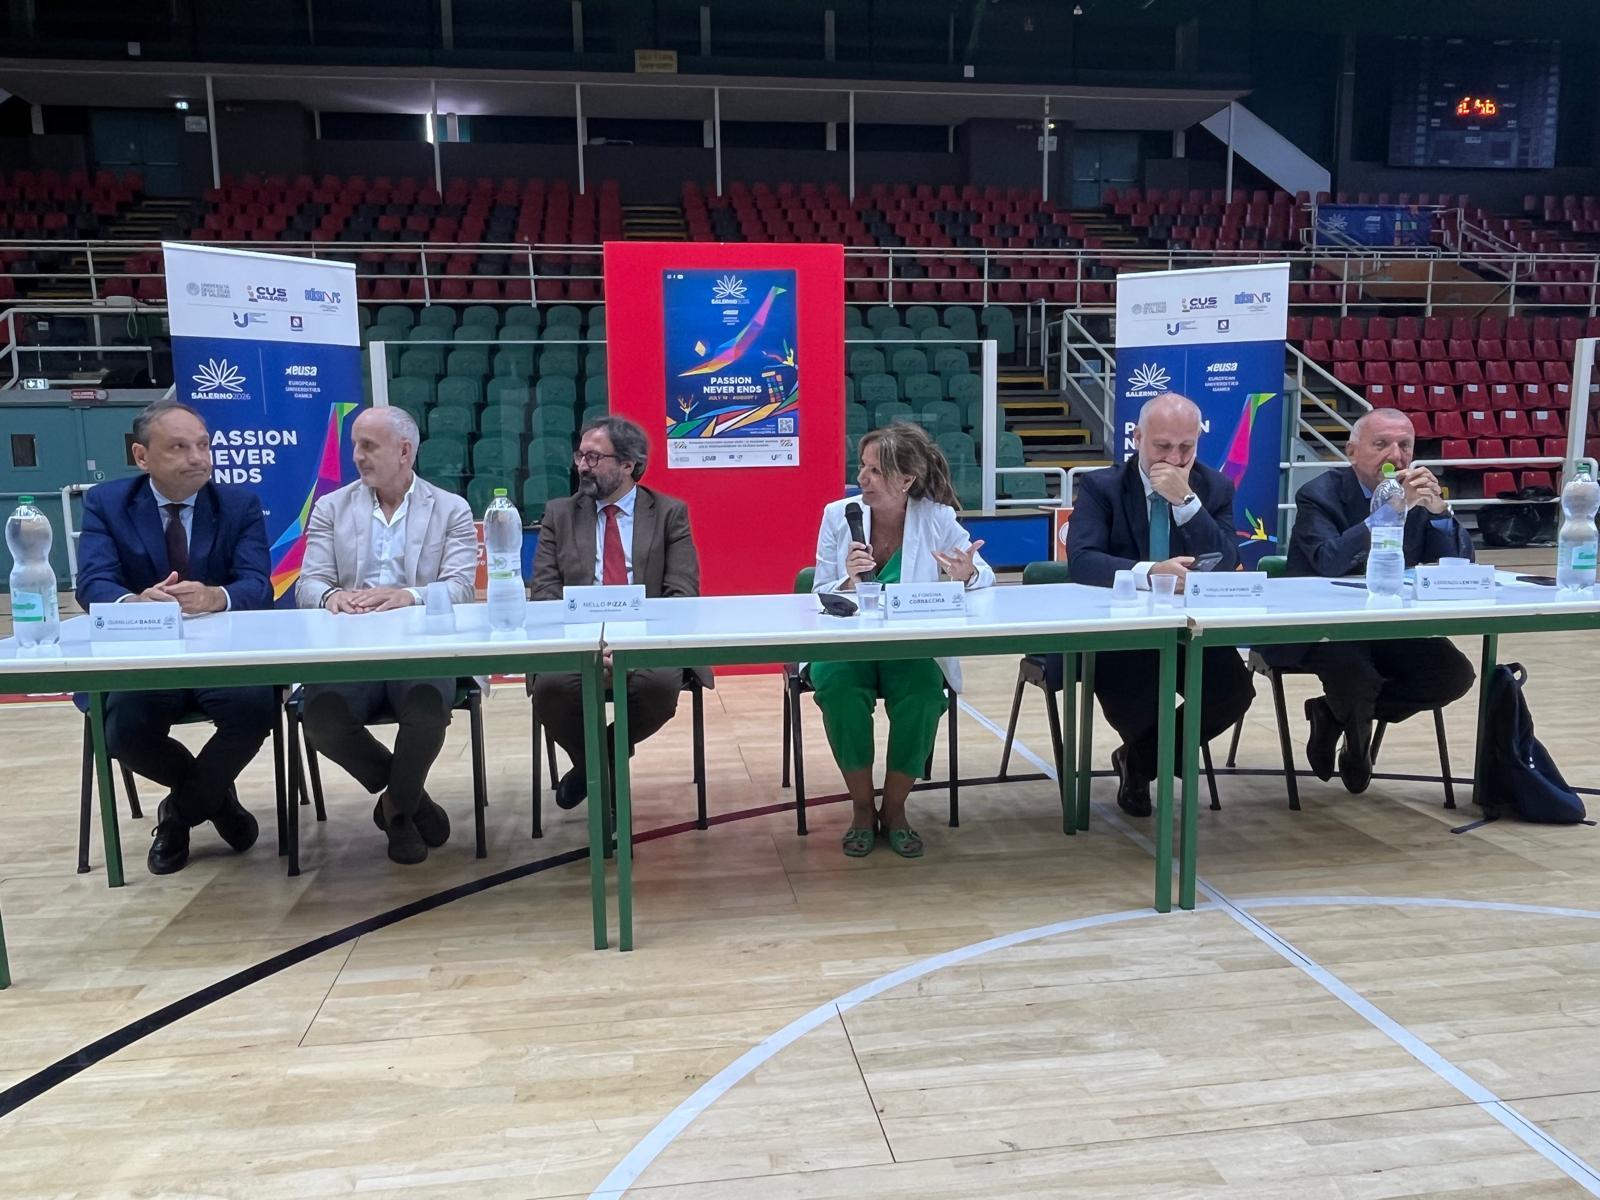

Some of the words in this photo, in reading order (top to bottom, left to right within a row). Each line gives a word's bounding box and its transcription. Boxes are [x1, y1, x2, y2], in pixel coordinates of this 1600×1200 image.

[256, 286, 287, 297] CUS
[1189, 296, 1218, 306] CUS
[703, 386, 735, 394] NEVER
[736, 385, 762, 393] ENDS
[211, 430, 298, 445] ASSION
[209, 449, 276, 465] EVER
[209, 468, 263, 484] NDS
